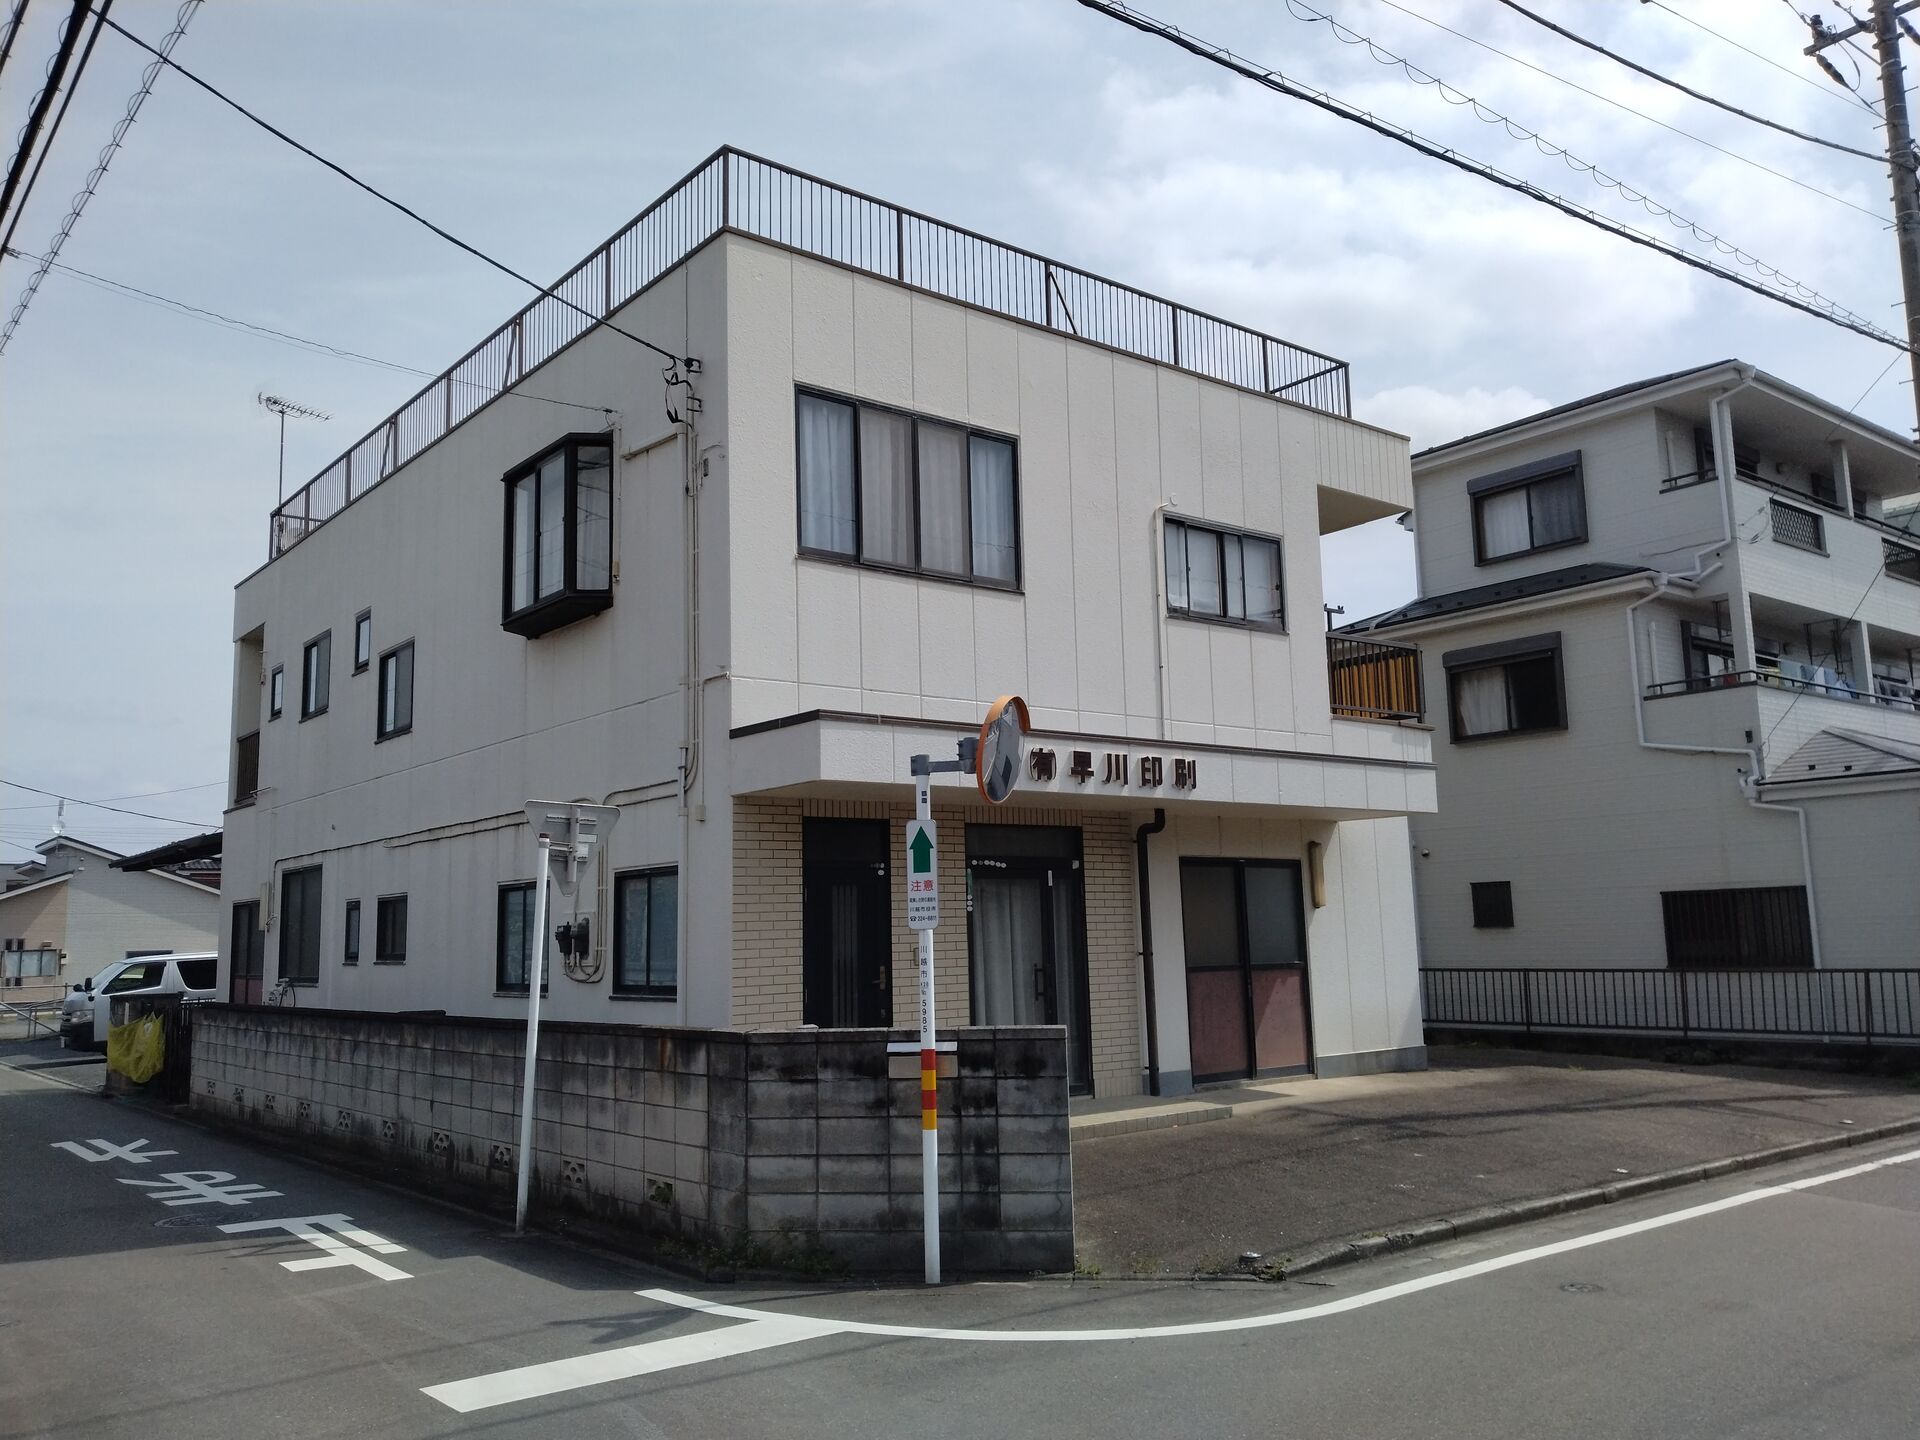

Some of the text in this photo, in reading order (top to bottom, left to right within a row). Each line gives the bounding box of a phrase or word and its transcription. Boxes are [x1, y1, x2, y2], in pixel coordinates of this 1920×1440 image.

[910, 879, 934, 892] 注意
[50, 1138, 415, 1281] 止まれ
